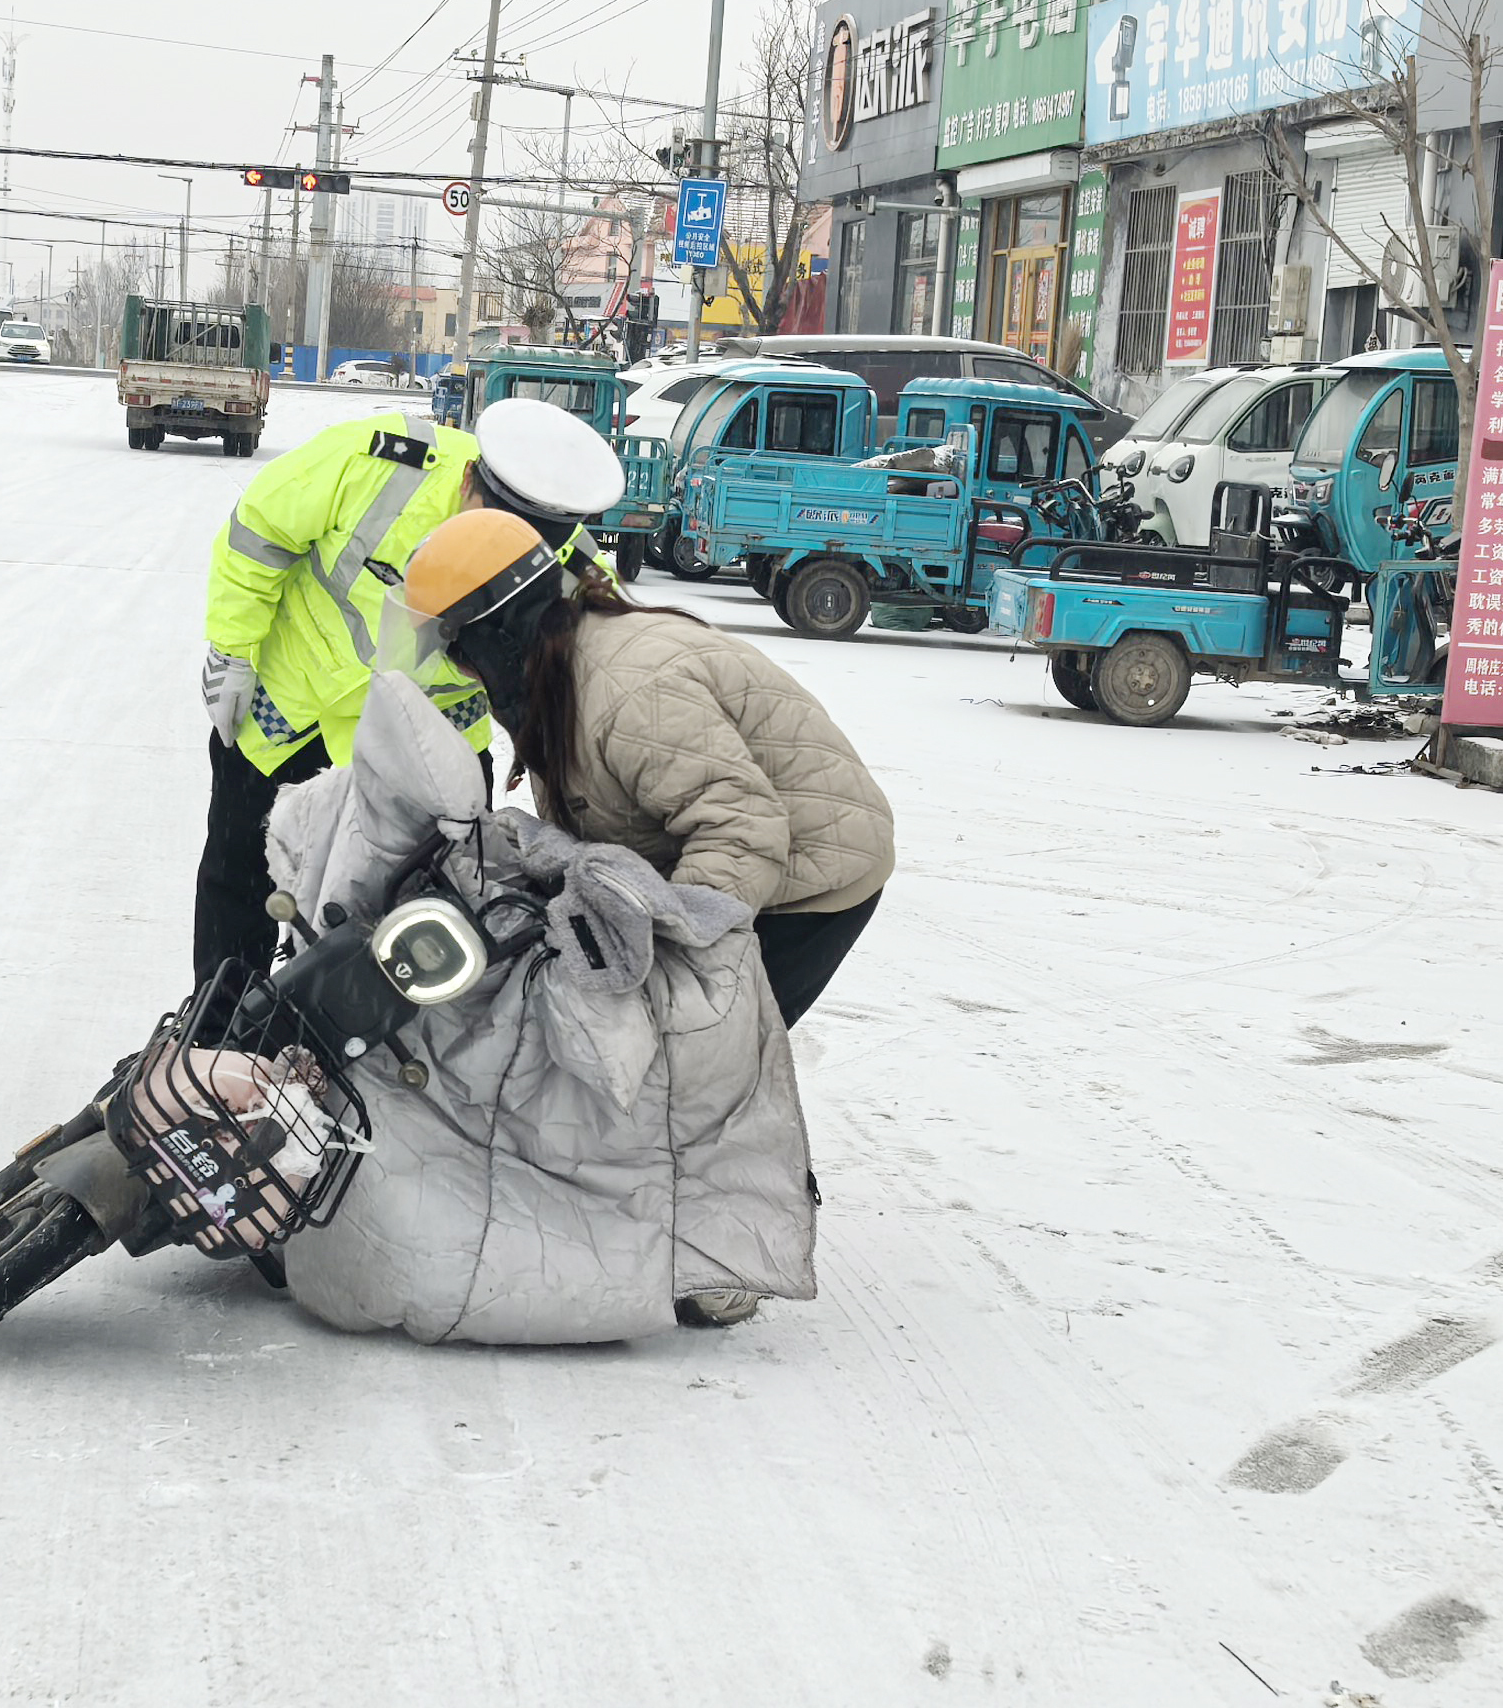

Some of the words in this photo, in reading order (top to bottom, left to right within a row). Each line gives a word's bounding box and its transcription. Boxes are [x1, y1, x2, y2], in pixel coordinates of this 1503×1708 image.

[450, 189, 469, 208] 50
[1469, 592, 1503, 611] 耽误
[1464, 657, 1503, 677] 周格庄
